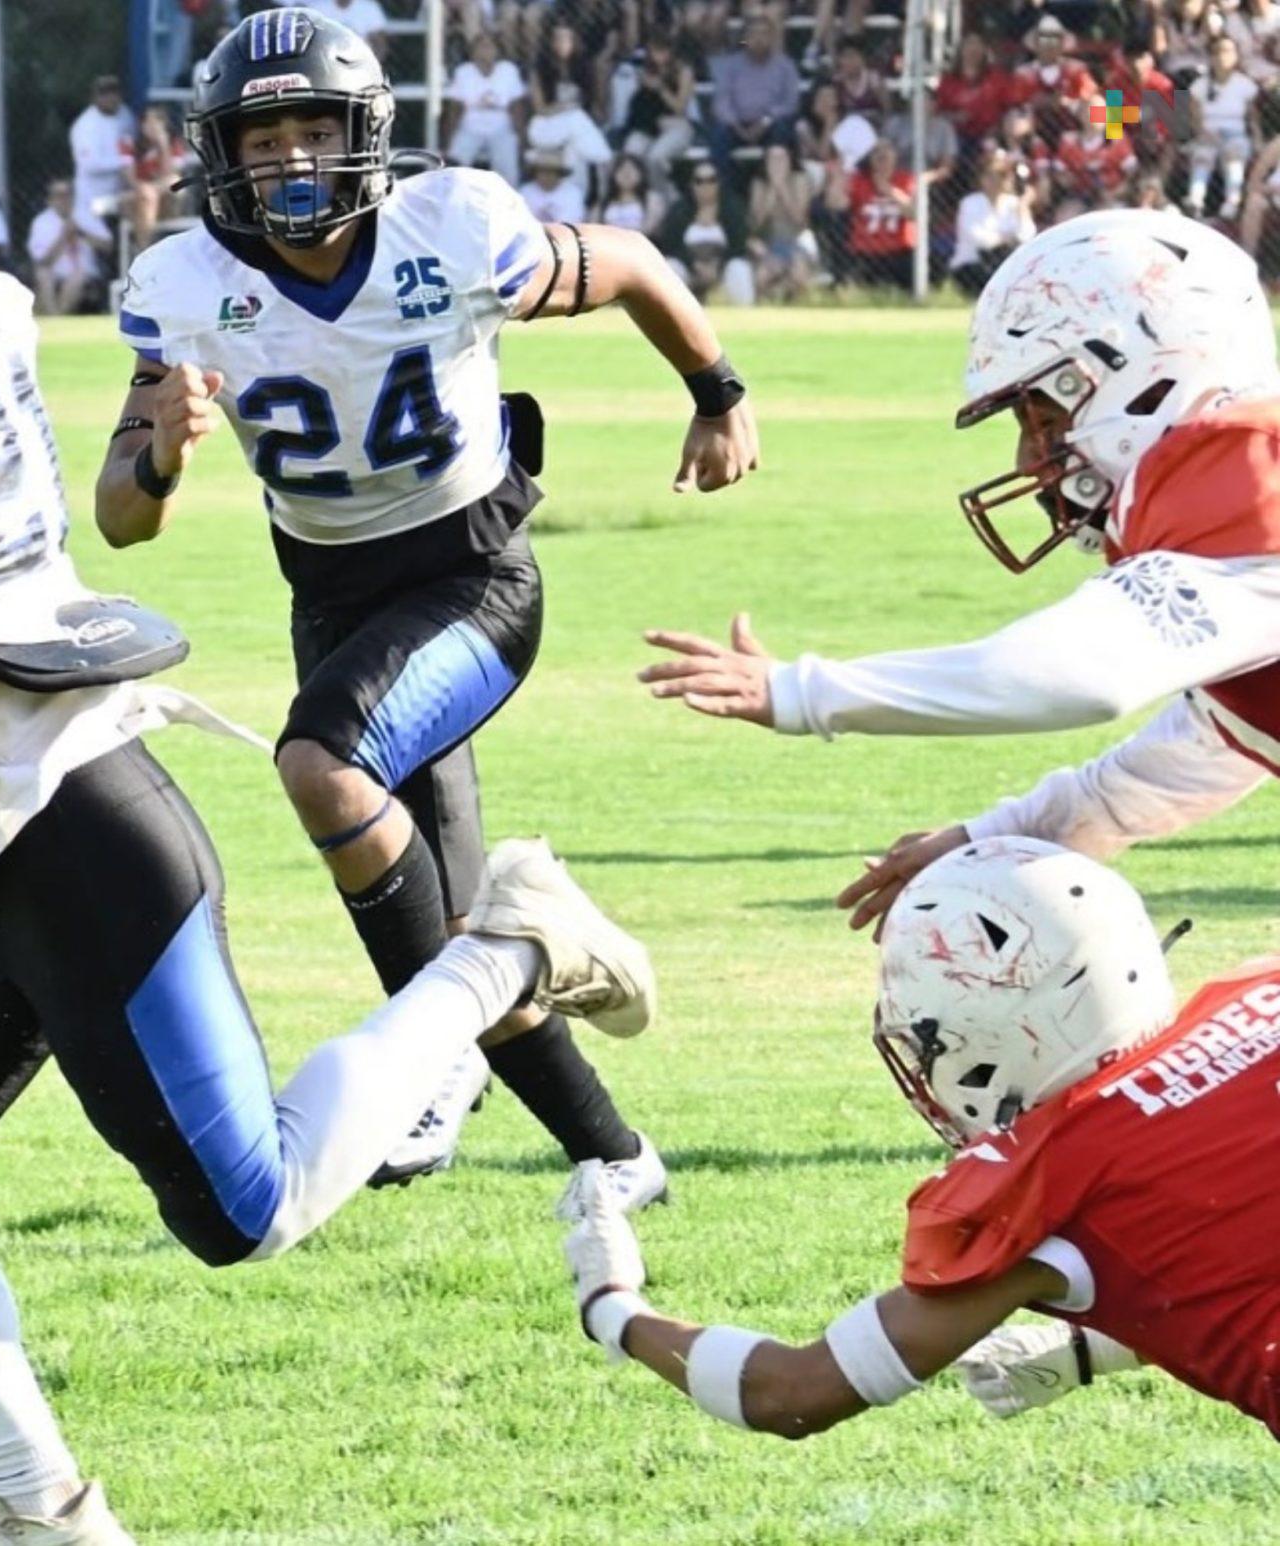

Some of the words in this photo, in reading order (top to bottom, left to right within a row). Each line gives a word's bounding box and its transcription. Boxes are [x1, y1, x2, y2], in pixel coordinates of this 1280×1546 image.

[394, 256, 452, 320] 25
[236, 344, 466, 498] 24
[1097, 983, 1280, 1117] TIGRES
[1159, 1029, 1280, 1109] BLANCOS
